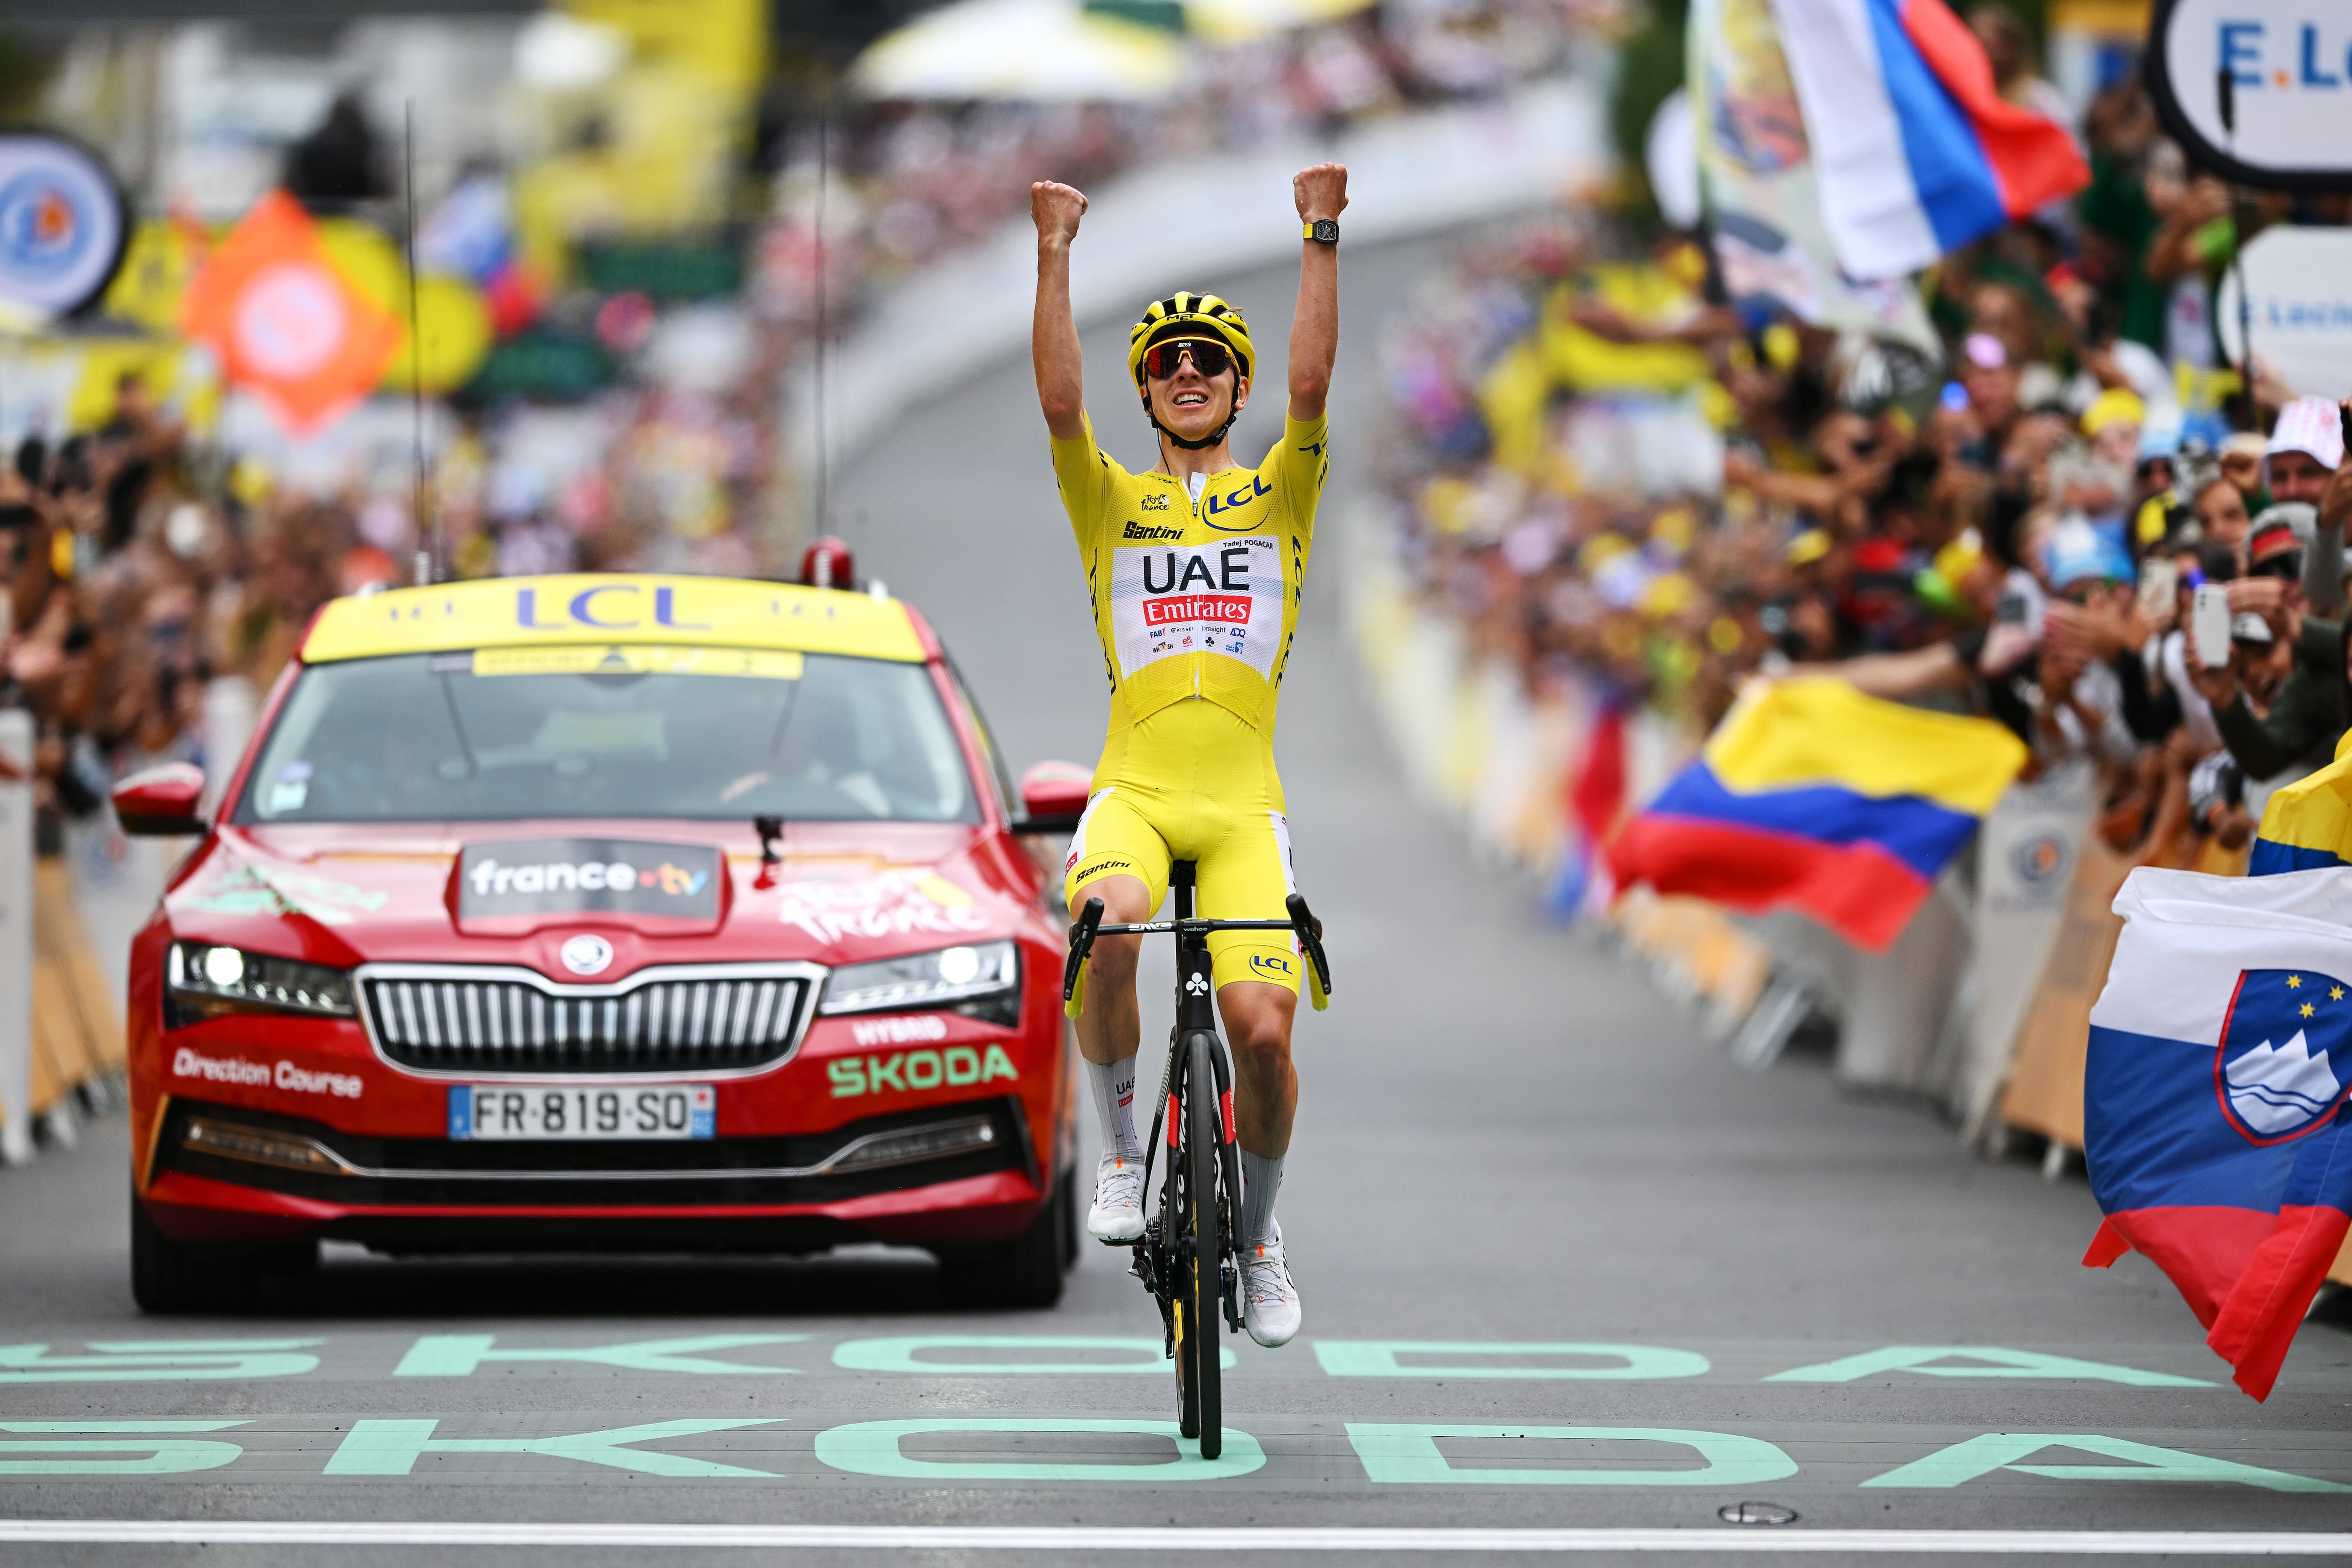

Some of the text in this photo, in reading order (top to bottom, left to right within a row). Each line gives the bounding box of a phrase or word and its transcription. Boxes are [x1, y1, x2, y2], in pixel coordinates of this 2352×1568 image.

[2219, 21, 2352, 86] E.L
[1210, 474, 1272, 514] LCL
[1122, 520, 1185, 540] Santini
[1245, 540, 1273, 550] POGACAR
[1143, 547, 1250, 594] UAE
[516, 584, 711, 631] LCL
[1146, 598, 1248, 622] Emirates
[1150, 630, 1163, 639] FAB
[1230, 627, 1246, 639] ADQ
[469, 859, 637, 895] france
[1075, 860, 1131, 885] Santini
[1254, 955, 1293, 975] LCL
[173, 1046, 363, 1099] Direction Course
[827, 1043, 1019, 1098] SKODA
